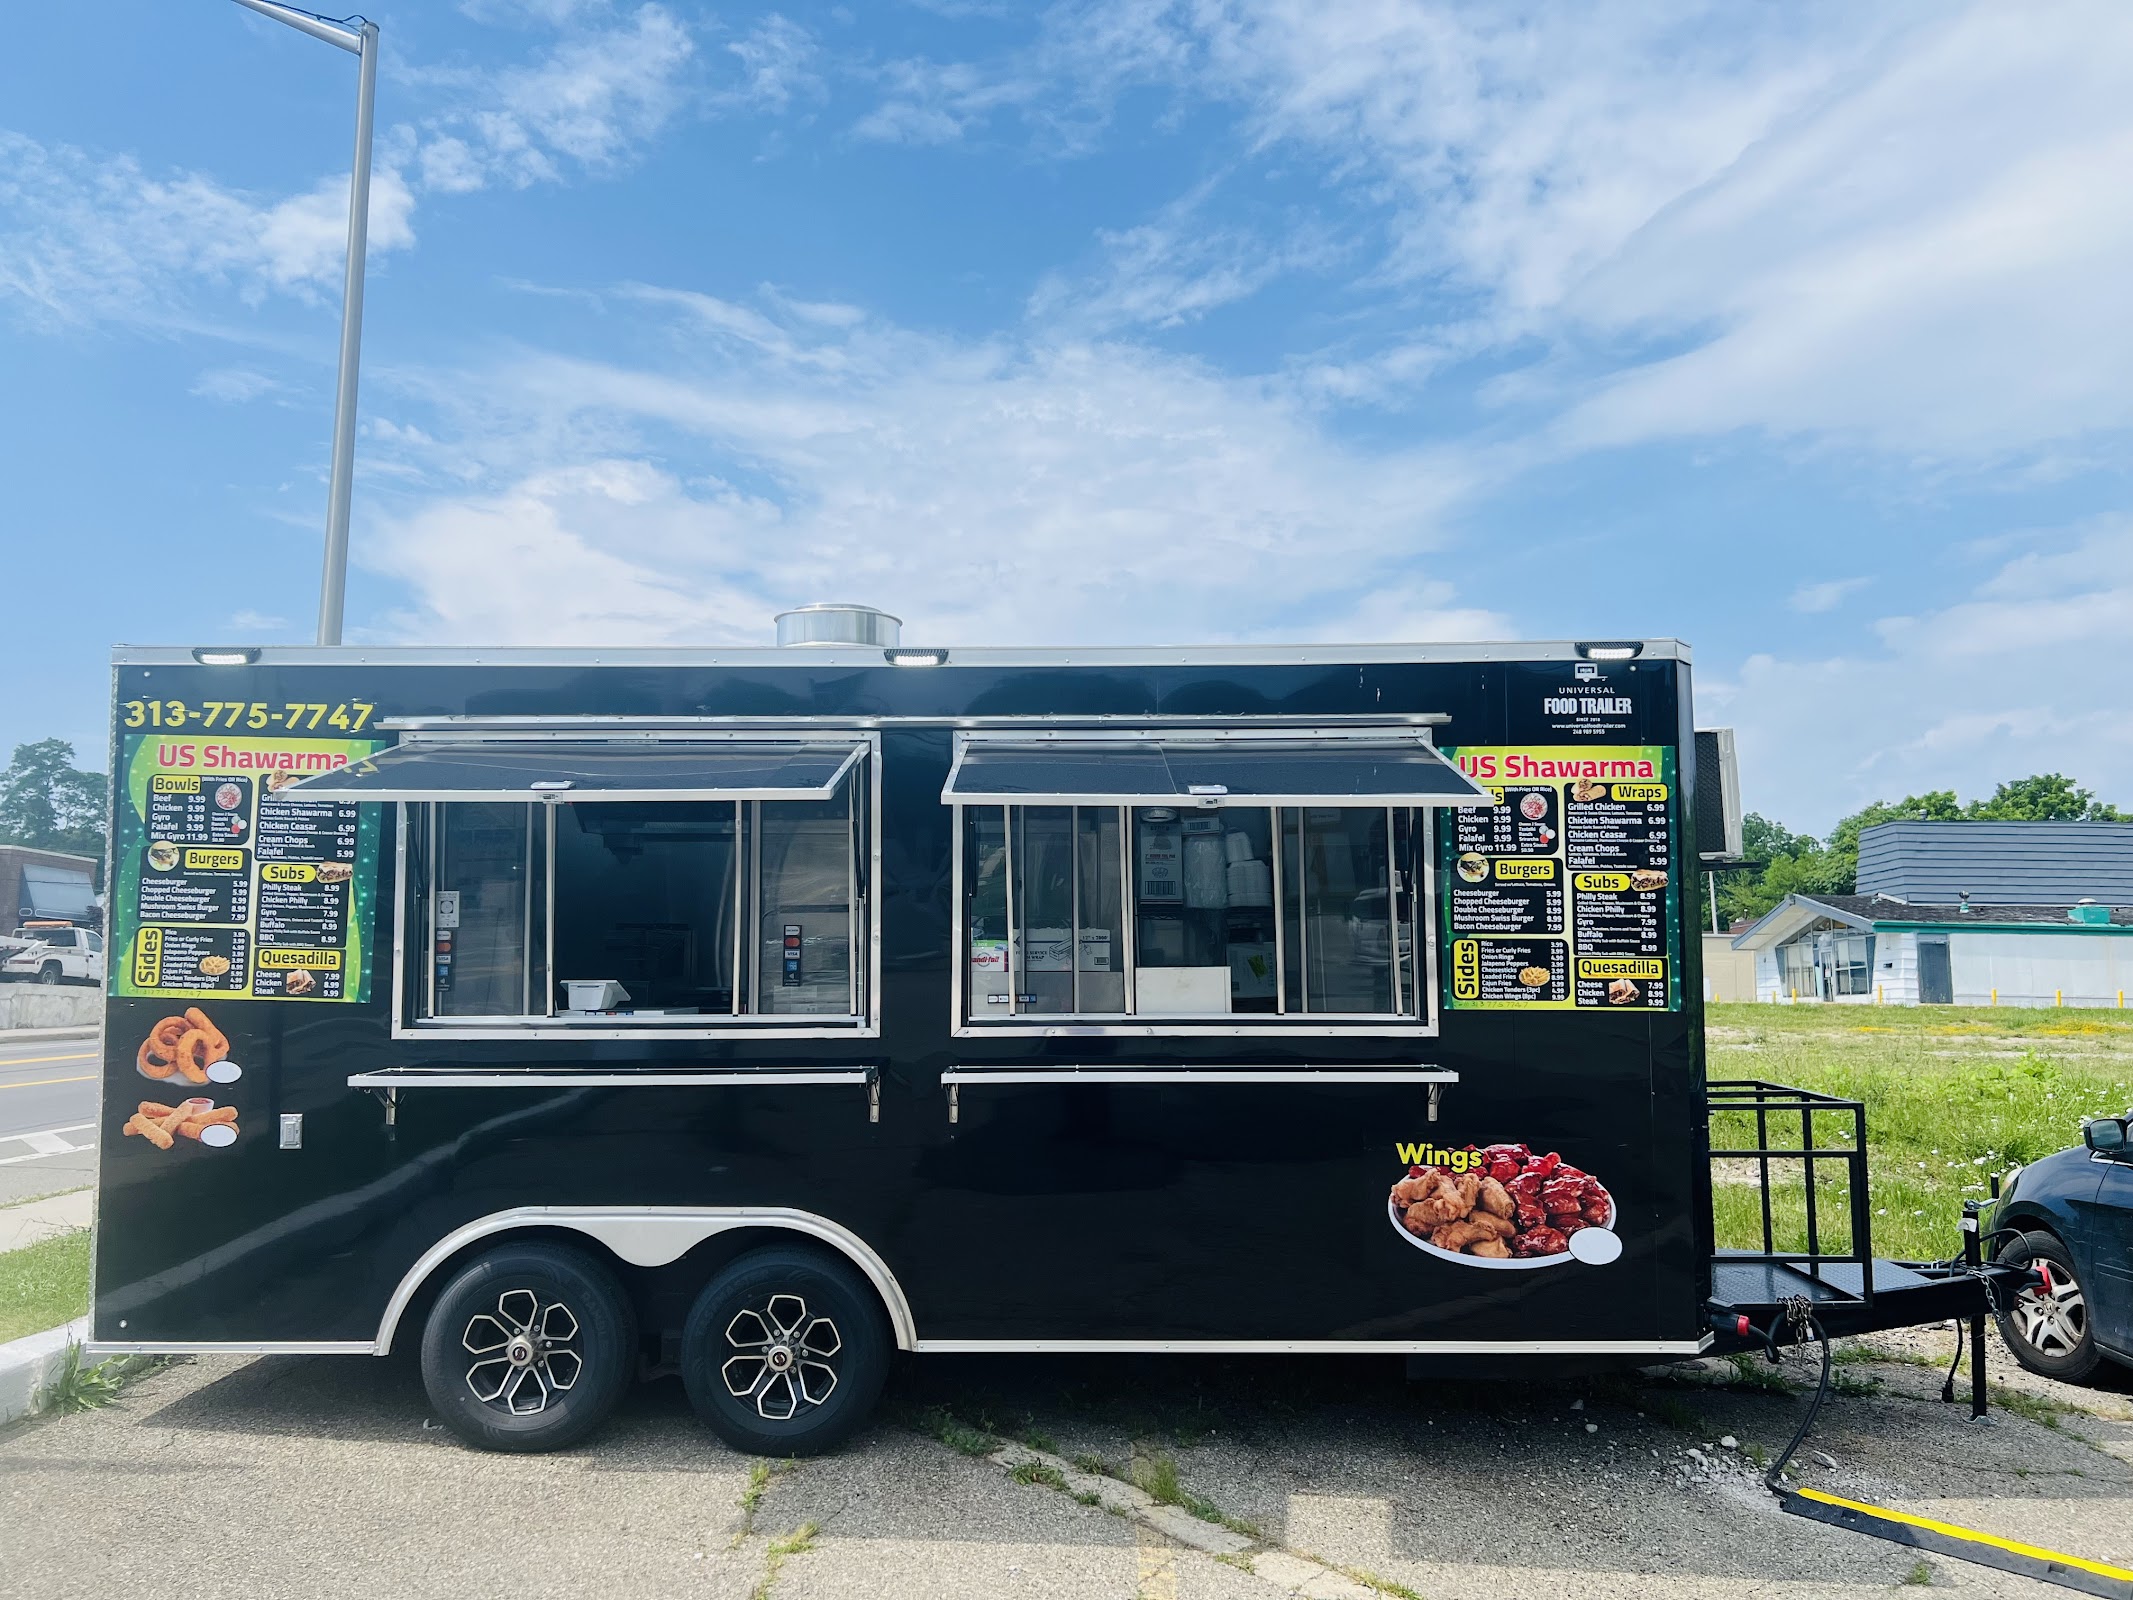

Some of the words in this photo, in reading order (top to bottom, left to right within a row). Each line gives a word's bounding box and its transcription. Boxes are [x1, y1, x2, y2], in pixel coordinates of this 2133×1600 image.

[1544, 698, 1577, 714] FOOD
[1579, 698, 1632, 714] TRAILER
[124, 700, 373, 730] 313-775-7747
[159, 745, 195, 767] US
[204, 745, 347, 770] Shawarma
[1460, 756, 1496, 778] US
[1505, 755, 1653, 778] Shawarma
[156, 778, 198, 790] Bowls
[1619, 786, 1661, 801] Wraps
[152, 814, 170, 822] Gyro
[291, 808, 332, 817] Shawarma
[1459, 825, 1477, 834] Gyro
[167, 833, 185, 841] Gyro
[285, 836, 308, 844] Chops
[1475, 844, 1493, 853] Gyro
[1595, 845, 1619, 853] Chops
[190, 853, 239, 867] Burgers
[270, 867, 304, 879] Subs
[1500, 864, 1550, 878] Burgers
[1584, 876, 1619, 888] Subs
[162, 912, 206, 920] Cheeseburger
[138, 931, 158, 982] Sides
[262, 951, 336, 965] Quesadilla
[1457, 943, 1474, 995] Sides
[1582, 961, 1658, 974] Quesadilla
[1396, 1143, 1483, 1173] Wings
